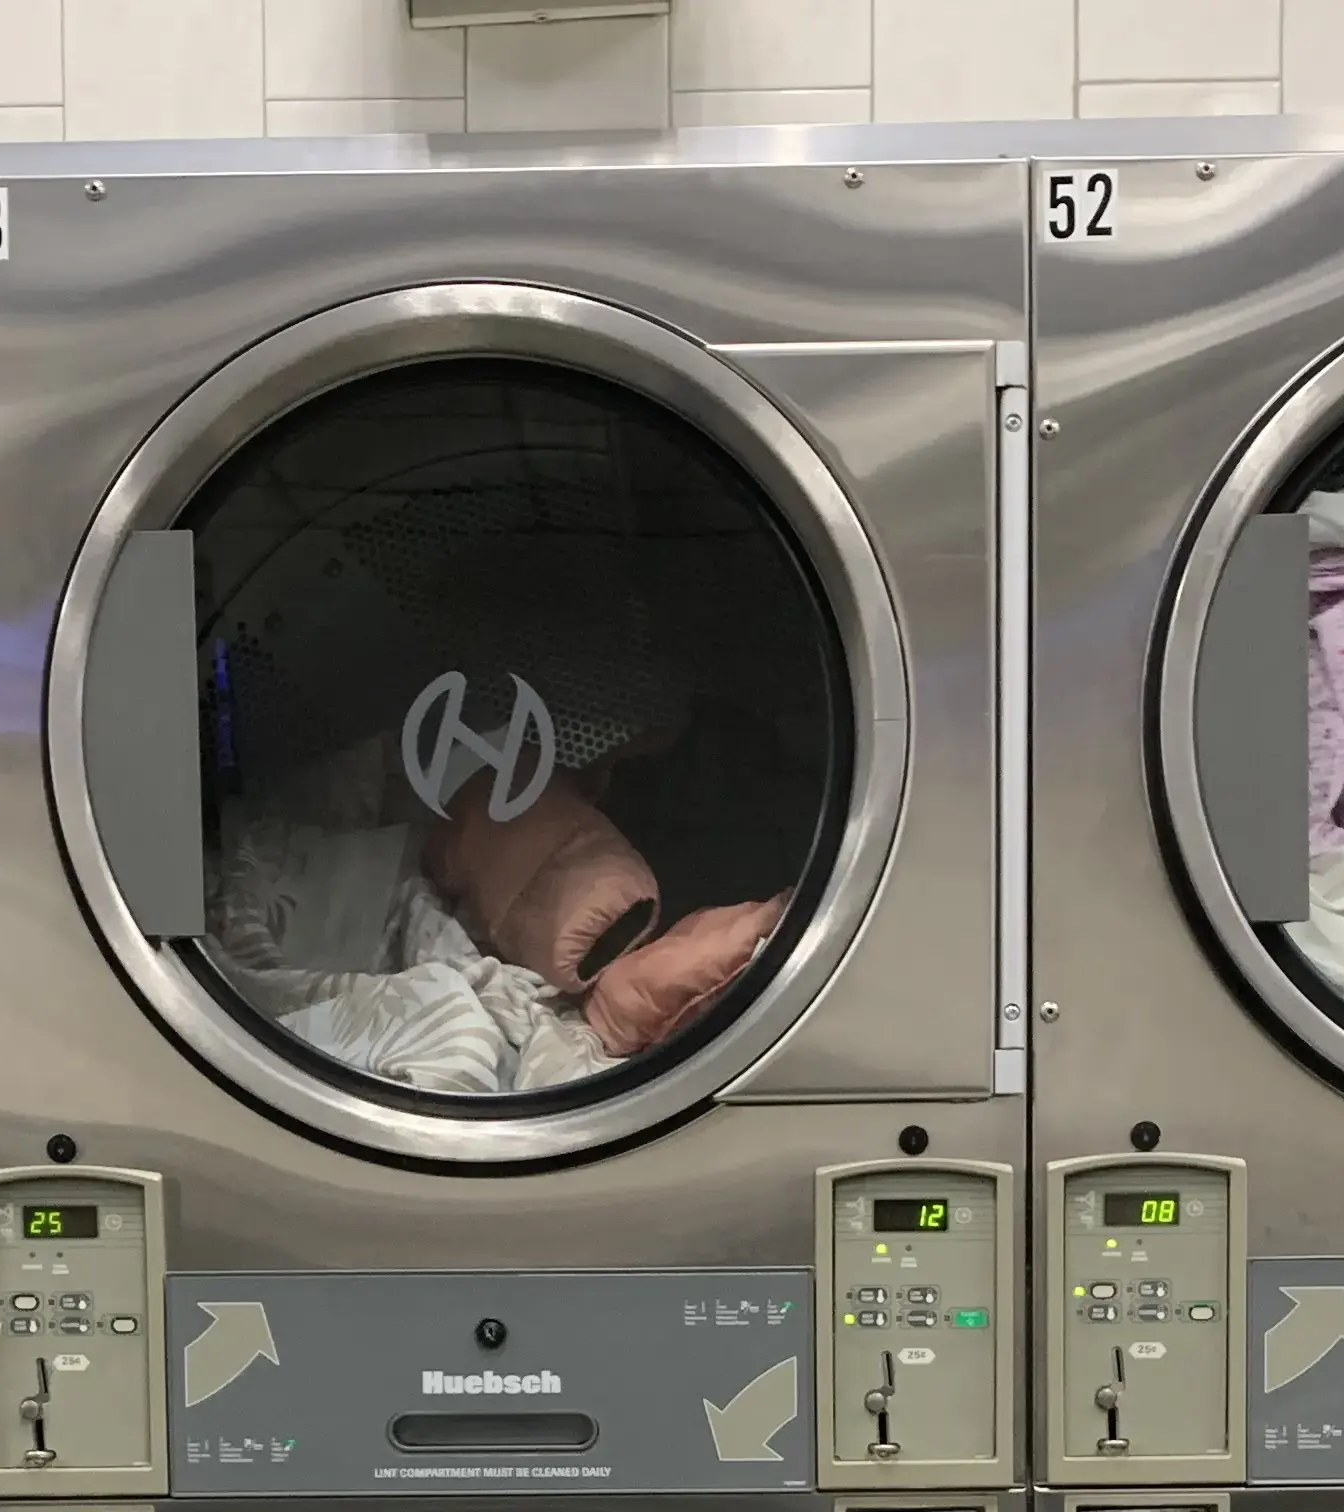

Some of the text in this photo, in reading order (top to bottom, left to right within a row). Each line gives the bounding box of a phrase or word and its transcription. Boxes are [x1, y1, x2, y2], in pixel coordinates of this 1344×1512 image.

[1049, 173, 1113, 239] 52
[30, 1211, 62, 1234] 25
[919, 1203, 945, 1228] 12
[1141, 1199, 1175, 1223] 08
[422, 1370, 562, 1394] Huebsch
[374, 1466, 612, 1479] LINT COMPARTMENT MUST BE CLEANED DAILY
